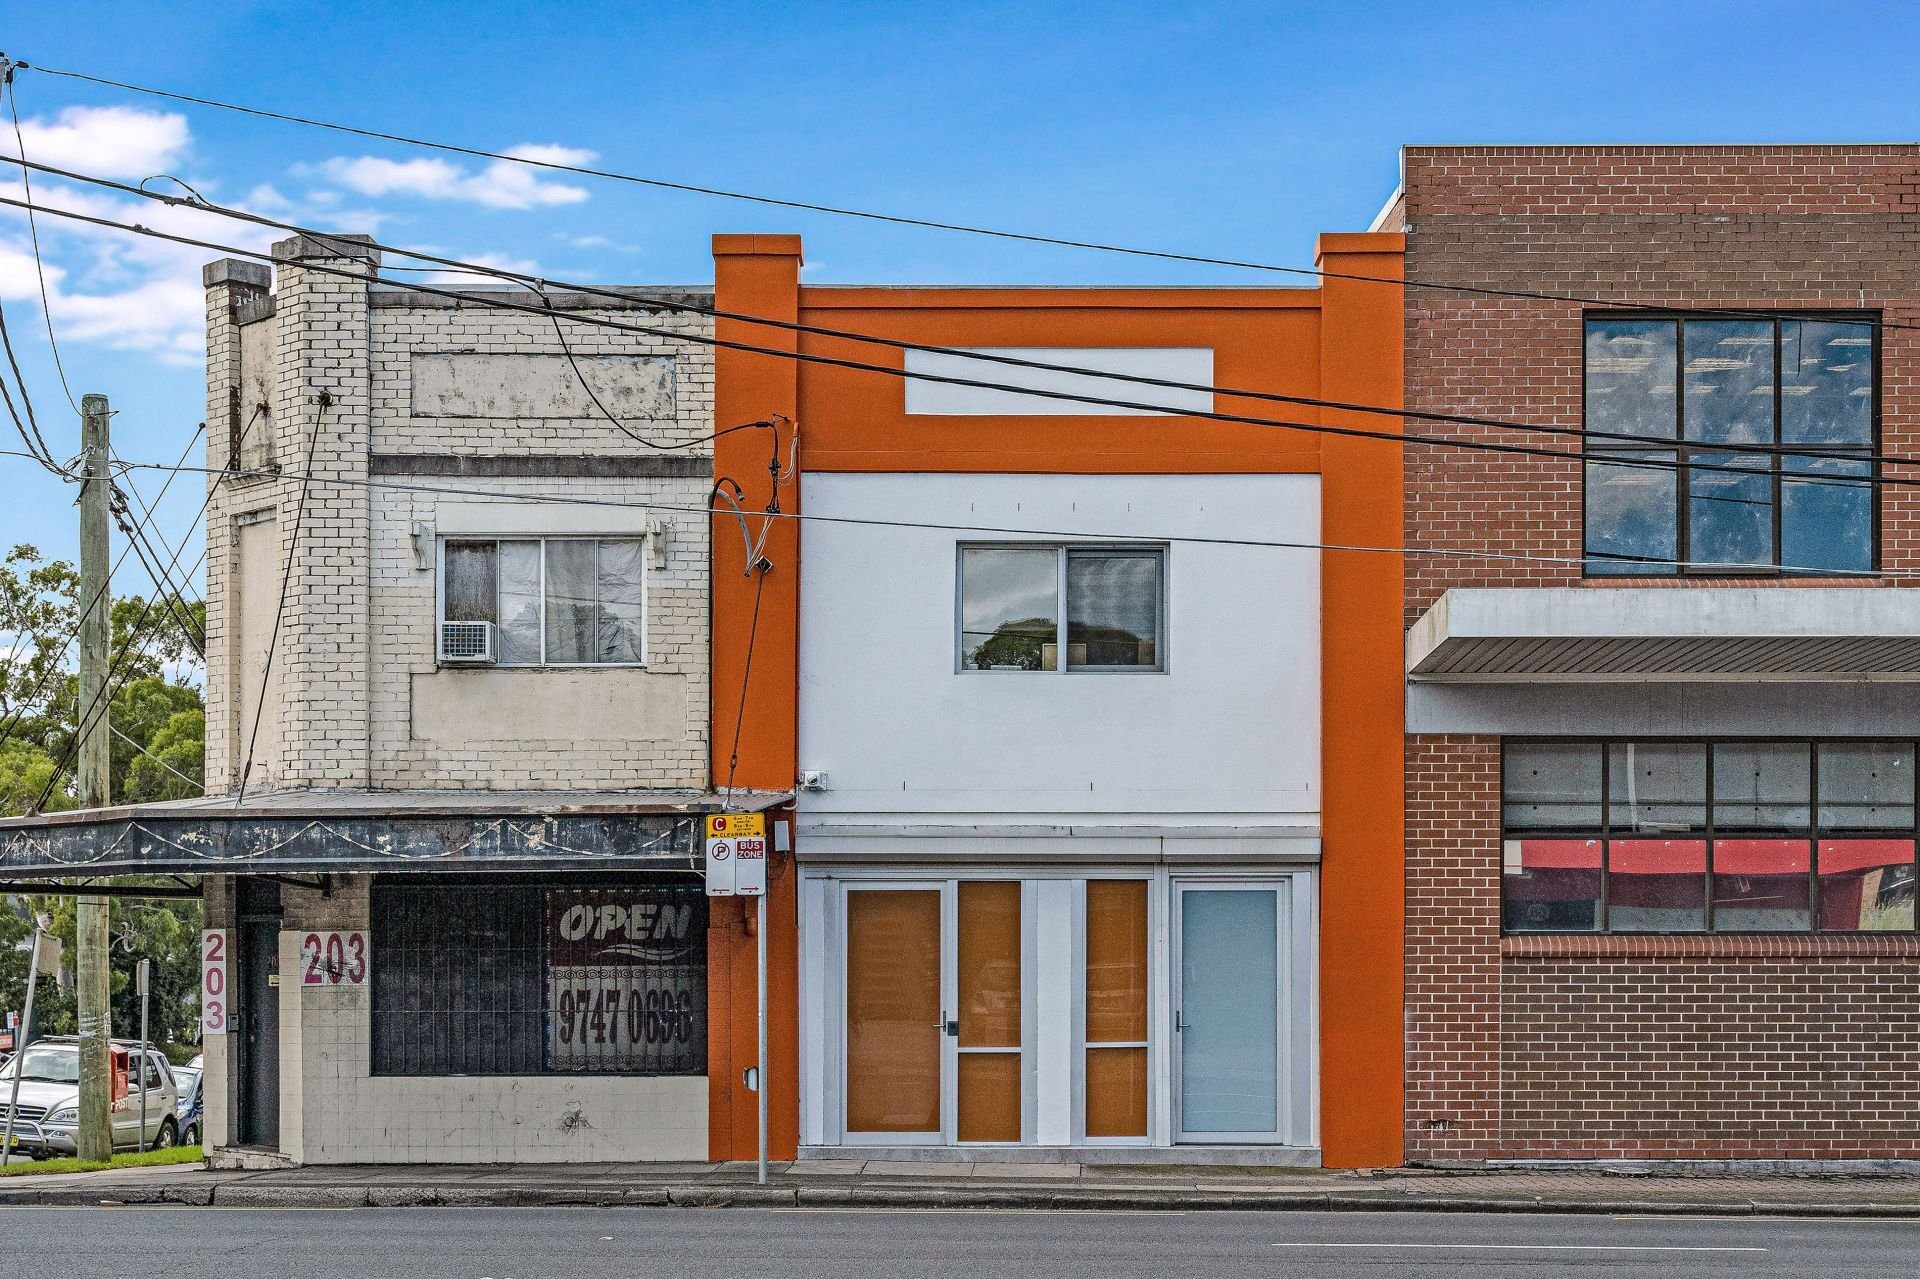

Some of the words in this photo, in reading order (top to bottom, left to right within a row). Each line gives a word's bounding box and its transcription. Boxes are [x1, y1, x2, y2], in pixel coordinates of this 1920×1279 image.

[716, 818, 724, 830] C
[559, 904, 692, 941] OPEN
[304, 932, 366, 984] 203
[205, 933, 224, 1030] 203
[559, 989, 624, 1045] 9747
[115, 1097, 129, 1111] POST
